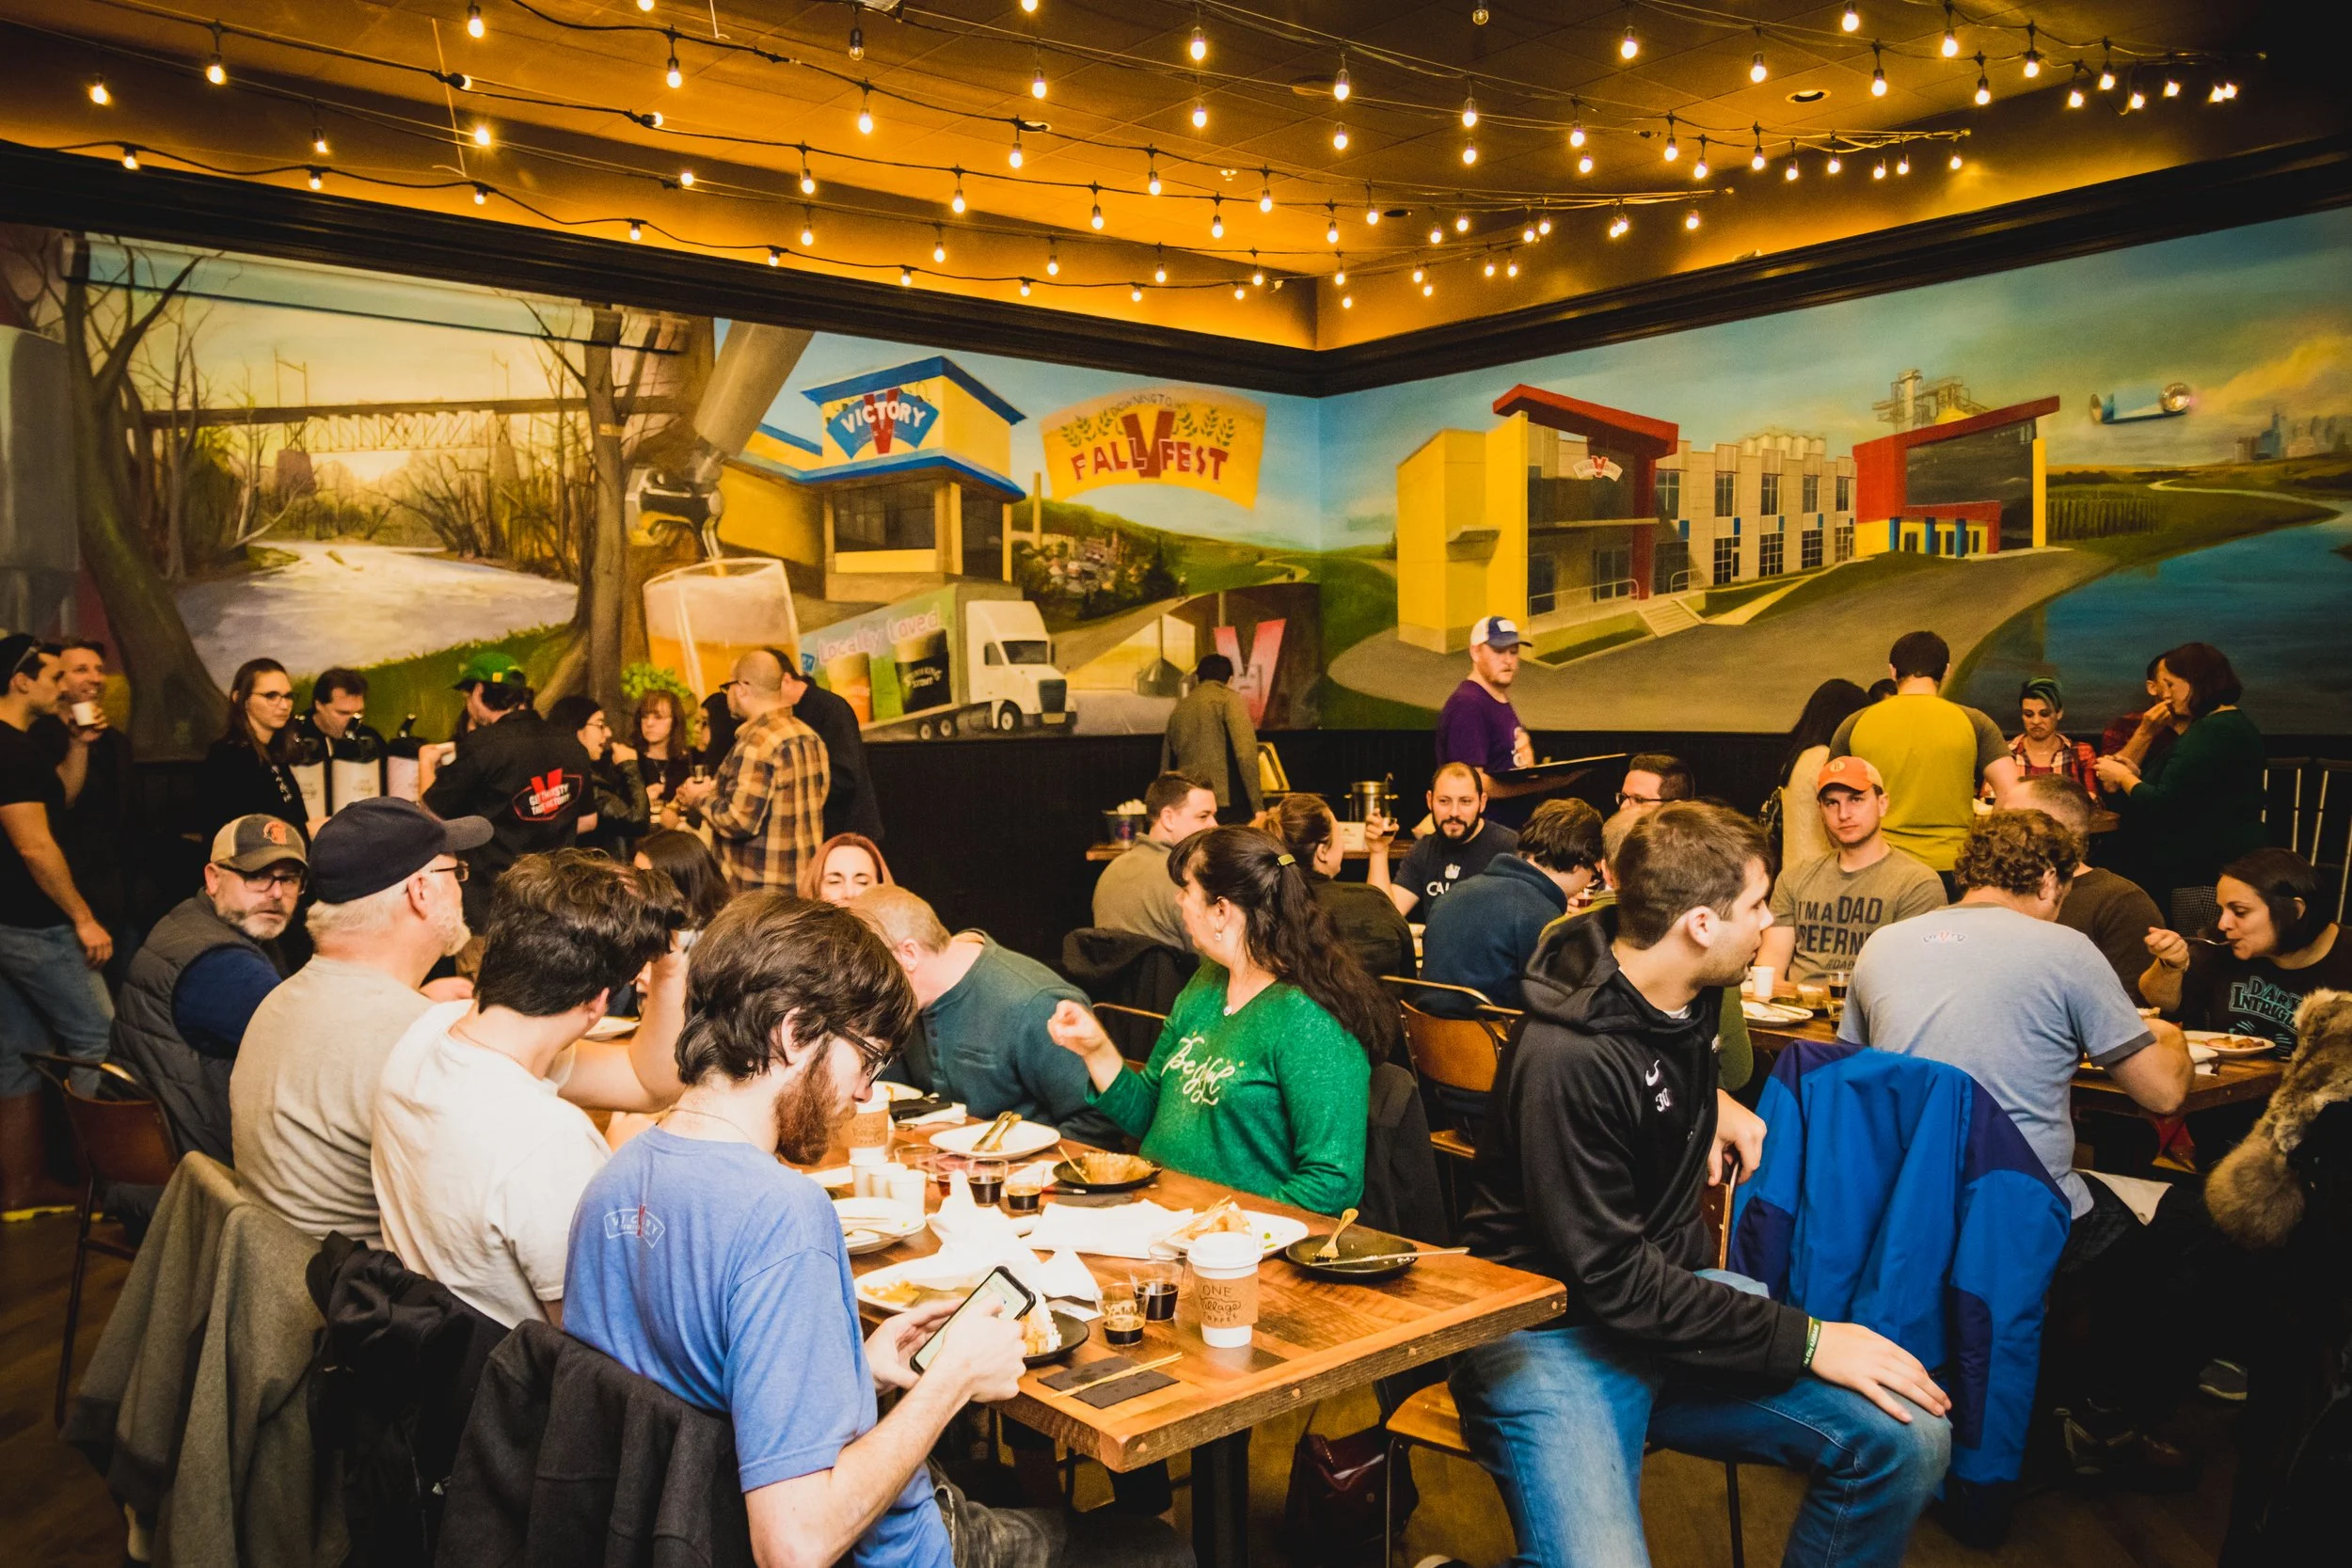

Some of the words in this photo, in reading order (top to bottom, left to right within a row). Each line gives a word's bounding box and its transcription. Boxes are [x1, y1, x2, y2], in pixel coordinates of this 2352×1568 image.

[840, 400, 927, 434] VICTORY
[1071, 437, 1148, 482] FALL
[1159, 438, 1230, 483] FEST
[818, 627, 885, 666] Locally
[887, 602, 941, 644] Loved
[1798, 900, 1820, 921] I'M
[1821, 903, 1833, 922] A
[1836, 895, 1883, 925] DAD
[1798, 924, 1872, 956] BEERN
[1202, 1285, 1232, 1297] ONE
